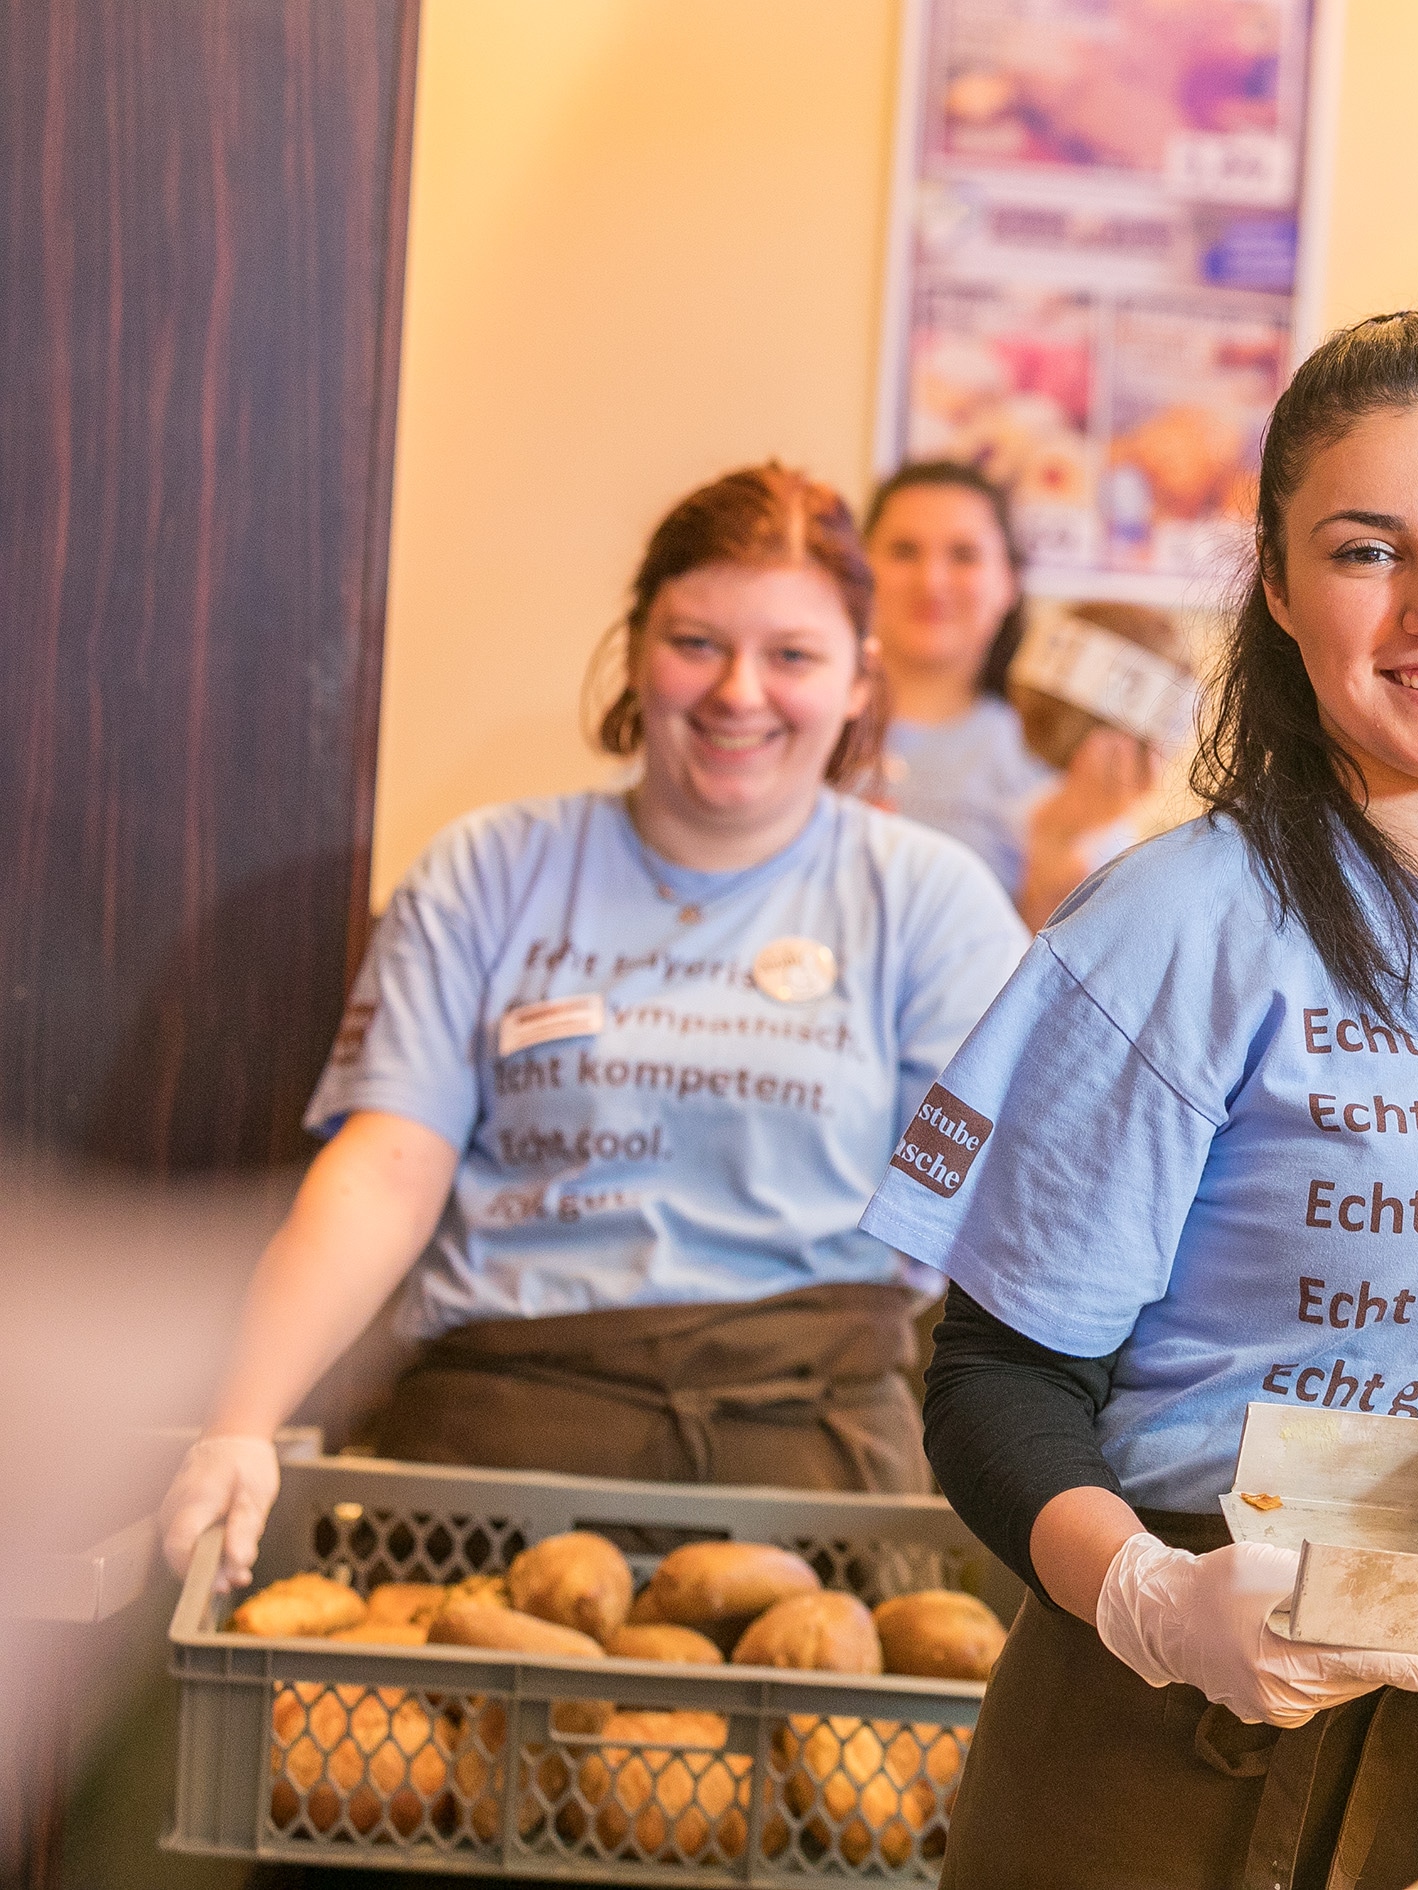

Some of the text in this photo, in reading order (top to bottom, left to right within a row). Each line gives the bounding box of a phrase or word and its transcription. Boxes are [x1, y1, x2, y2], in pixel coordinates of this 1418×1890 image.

[917, 1103, 981, 1152] stube
[1299, 1276, 1416, 1330] Echt
[1262, 1359, 1386, 1412] Echt
